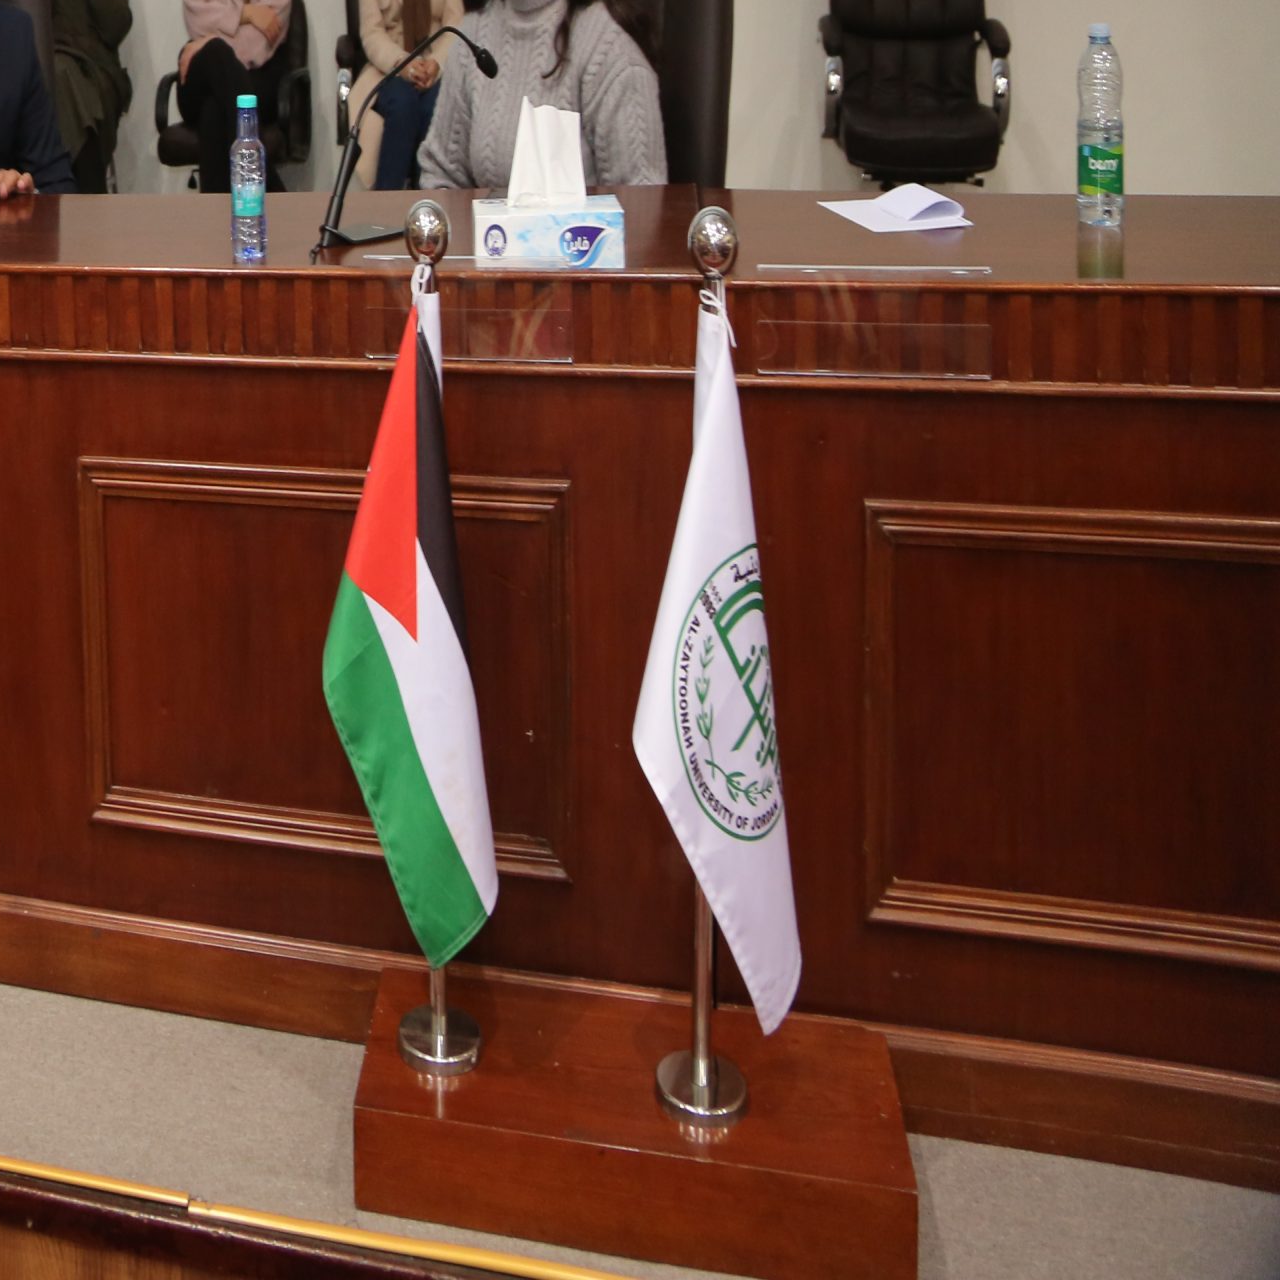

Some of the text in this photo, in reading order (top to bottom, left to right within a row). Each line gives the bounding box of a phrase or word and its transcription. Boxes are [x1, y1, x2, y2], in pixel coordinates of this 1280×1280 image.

[678, 615, 702, 749] AL-ZAYTOONAH
[688, 752, 734, 825] UNIVERSITY
[735, 815, 749, 831] OF
